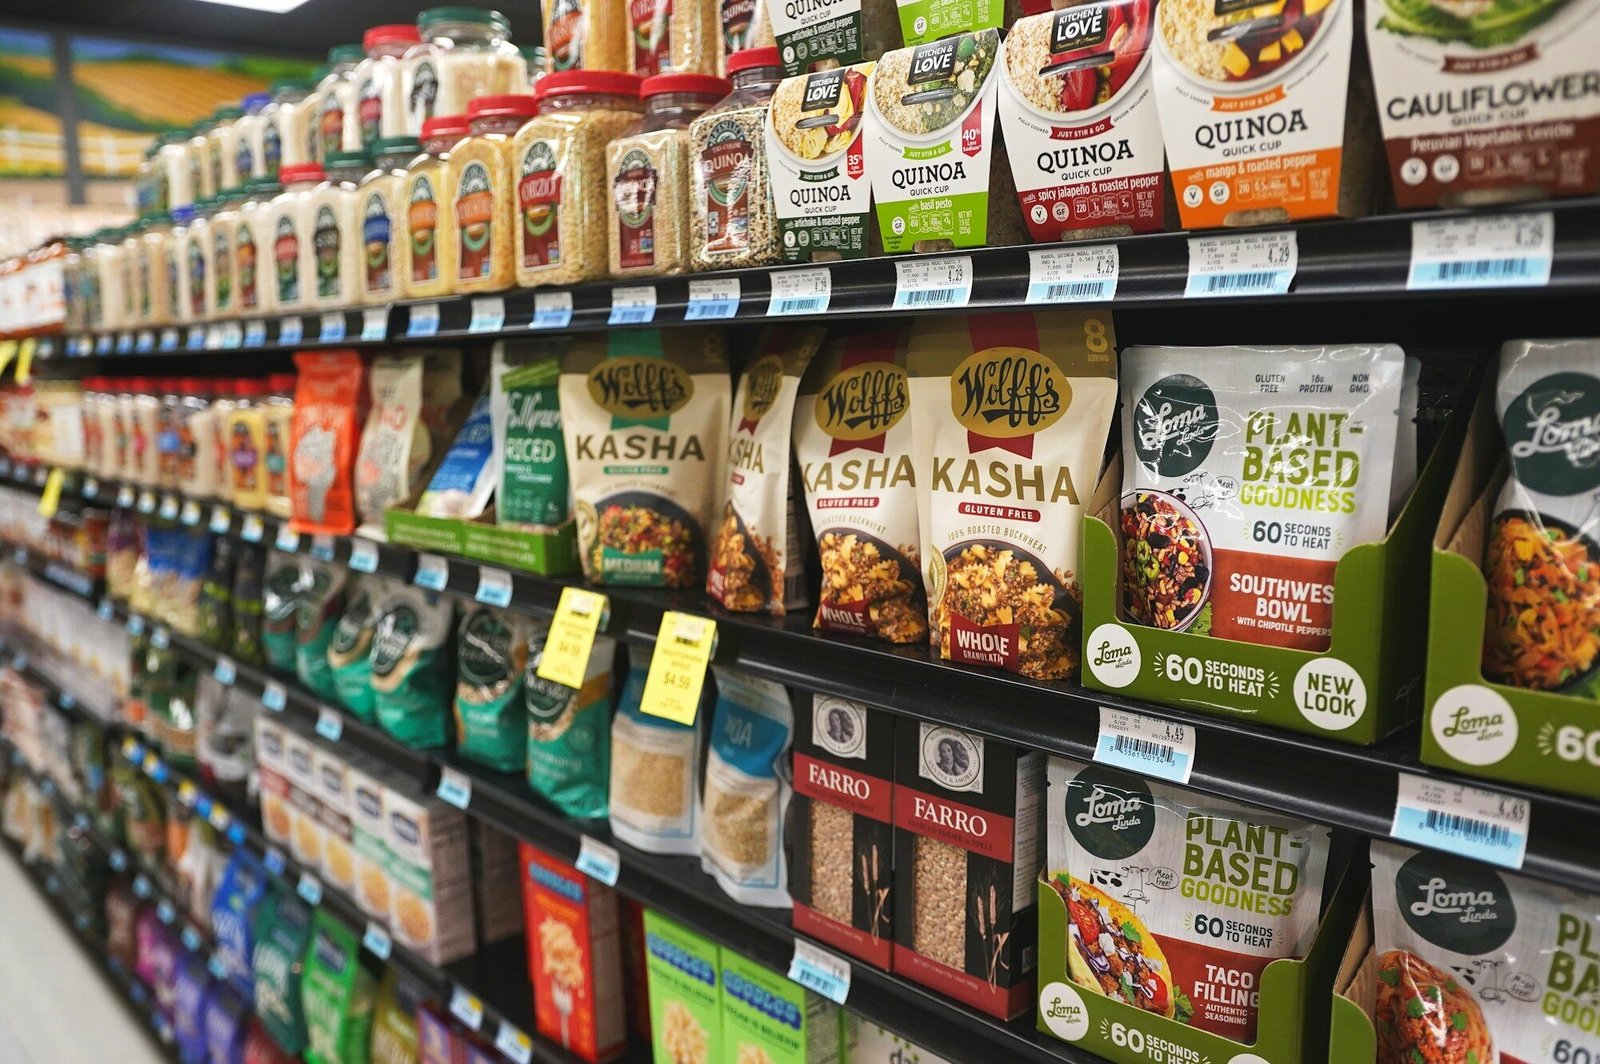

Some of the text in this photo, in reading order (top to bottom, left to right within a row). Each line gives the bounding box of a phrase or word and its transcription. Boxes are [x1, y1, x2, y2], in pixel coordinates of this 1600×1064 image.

[801, 10, 831, 25] QUICK CUP
[1059, 6, 1103, 24] KITCHEN &
[1056, 15, 1102, 42] LOVE
[914, 53, 952, 74] LOVE
[917, 48, 946, 59] KITCHEN
[806, 84, 839, 102] LOVE
[810, 77, 834, 88] KITCHEN
[1220, 101, 1238, 110] JUST
[1240, 99, 1256, 109] STIR
[1387, 70, 1600, 120] CAULIFLOWER
[1196, 108, 1308, 149] QUINOA
[1452, 108, 1528, 128] QUICK CUP
[1057, 130, 1073, 138] JUST
[1074, 128, 1089, 137] STIR
[1096, 124, 1106, 132] GO
[1223, 140, 1282, 157] QUICK CUP
[1411, 134, 1461, 154] Peruvian
[1037, 139, 1134, 174] QUINOA
[1206, 154, 1317, 179] mango & roasted pepper
[892, 162, 966, 190] QUINOA
[1061, 166, 1112, 181] QUICK CUP
[521, 177, 556, 200] ORZO
[790, 184, 851, 207] QUINOA
[910, 185, 950, 196] QUICK CUP
[1038, 190, 1056, 202] spicy
[1057, 184, 1090, 200] jalapeño
[1091, 182, 1098, 193] &
[1099, 178, 1128, 192] roasted
[1130, 176, 1159, 190] pepper
[805, 206, 822, 214] QUICK
[920, 198, 952, 210] basil pesto
[1268, 246, 1290, 263] 4.29
[948, 268, 963, 282] 4.29
[1096, 259, 1114, 274] 4.29
[1084, 318, 1108, 353] 8
[1254, 373, 1286, 384] GLUTEN
[1260, 384, 1280, 394] FREE
[1299, 384, 1333, 394] PROTEIN
[1350, 384, 1370, 394] GMO
[1352, 373, 1370, 383] NON
[823, 370, 906, 430] Wolff's
[958, 356, 1060, 429] Wolff's
[1142, 402, 1206, 449] Loma
[1245, 410, 1364, 448] PLANT-
[576, 434, 706, 461] KASHA
[803, 454, 916, 493] KASHA
[1242, 446, 1360, 488] BASED
[932, 456, 1080, 506] KASHA
[818, 498, 875, 508] GLUTEN FREE
[1240, 485, 1356, 514] GOODNESS
[964, 504, 1034, 520] GLUTEN FREE
[967, 525, 1001, 535] ROASTED
[1004, 527, 1048, 554] BUCKWHEAT
[1252, 520, 1282, 544] 60
[1284, 522, 1332, 537] SECONDS
[1284, 535, 1330, 550] TO HEAT
[1230, 572, 1335, 605] SOUTHWES
[822, 604, 867, 627] WHOLE
[1256, 597, 1312, 624] BOWL
[1237, 616, 1332, 636] WITH CHIPOTLE PEPPERS
[956, 628, 1010, 656] WHOLE
[1094, 640, 1132, 666] Loma
[1165, 654, 1203, 686] 60
[1204, 660, 1265, 682] SECONDS
[1205, 674, 1264, 697] TO HEAT
[1308, 672, 1354, 696] NEW
[1304, 691, 1356, 718] LOOK
[1166, 725, 1184, 741] 4.49
[1443, 706, 1504, 738] Loma
[809, 763, 870, 800] FARRO
[914, 796, 988, 837] FARRO
[1076, 789, 1142, 826] Loma
[1499, 800, 1526, 820] 4.49
[1112, 816, 1141, 831] Linda
[1186, 812, 1303, 858] PLANT-
[1154, 868, 1174, 880] Meat
[1183, 843, 1298, 896] BASED
[1155, 878, 1172, 889] Free!
[1180, 878, 1293, 918] GOODNESS
[1410, 877, 1496, 916] Loma
[1194, 914, 1224, 938] 60
[1460, 906, 1498, 923] Linda
[1226, 920, 1273, 938] SECONDS
[1226, 930, 1272, 949] TO HEAT
[1205, 964, 1254, 990] TACO
[1194, 982, 1260, 1008] FILLING
[1046, 996, 1081, 1018] Loma
[1205, 1004, 1248, 1017] AUTHENTIC
[1204, 1012, 1248, 1026] SEASONING
[1111, 1022, 1144, 1054] 60
[1146, 1034, 1200, 1062] SECONDS
[1146, 1047, 1164, 1064] TO
[1553, 1038, 1591, 1064] 60
